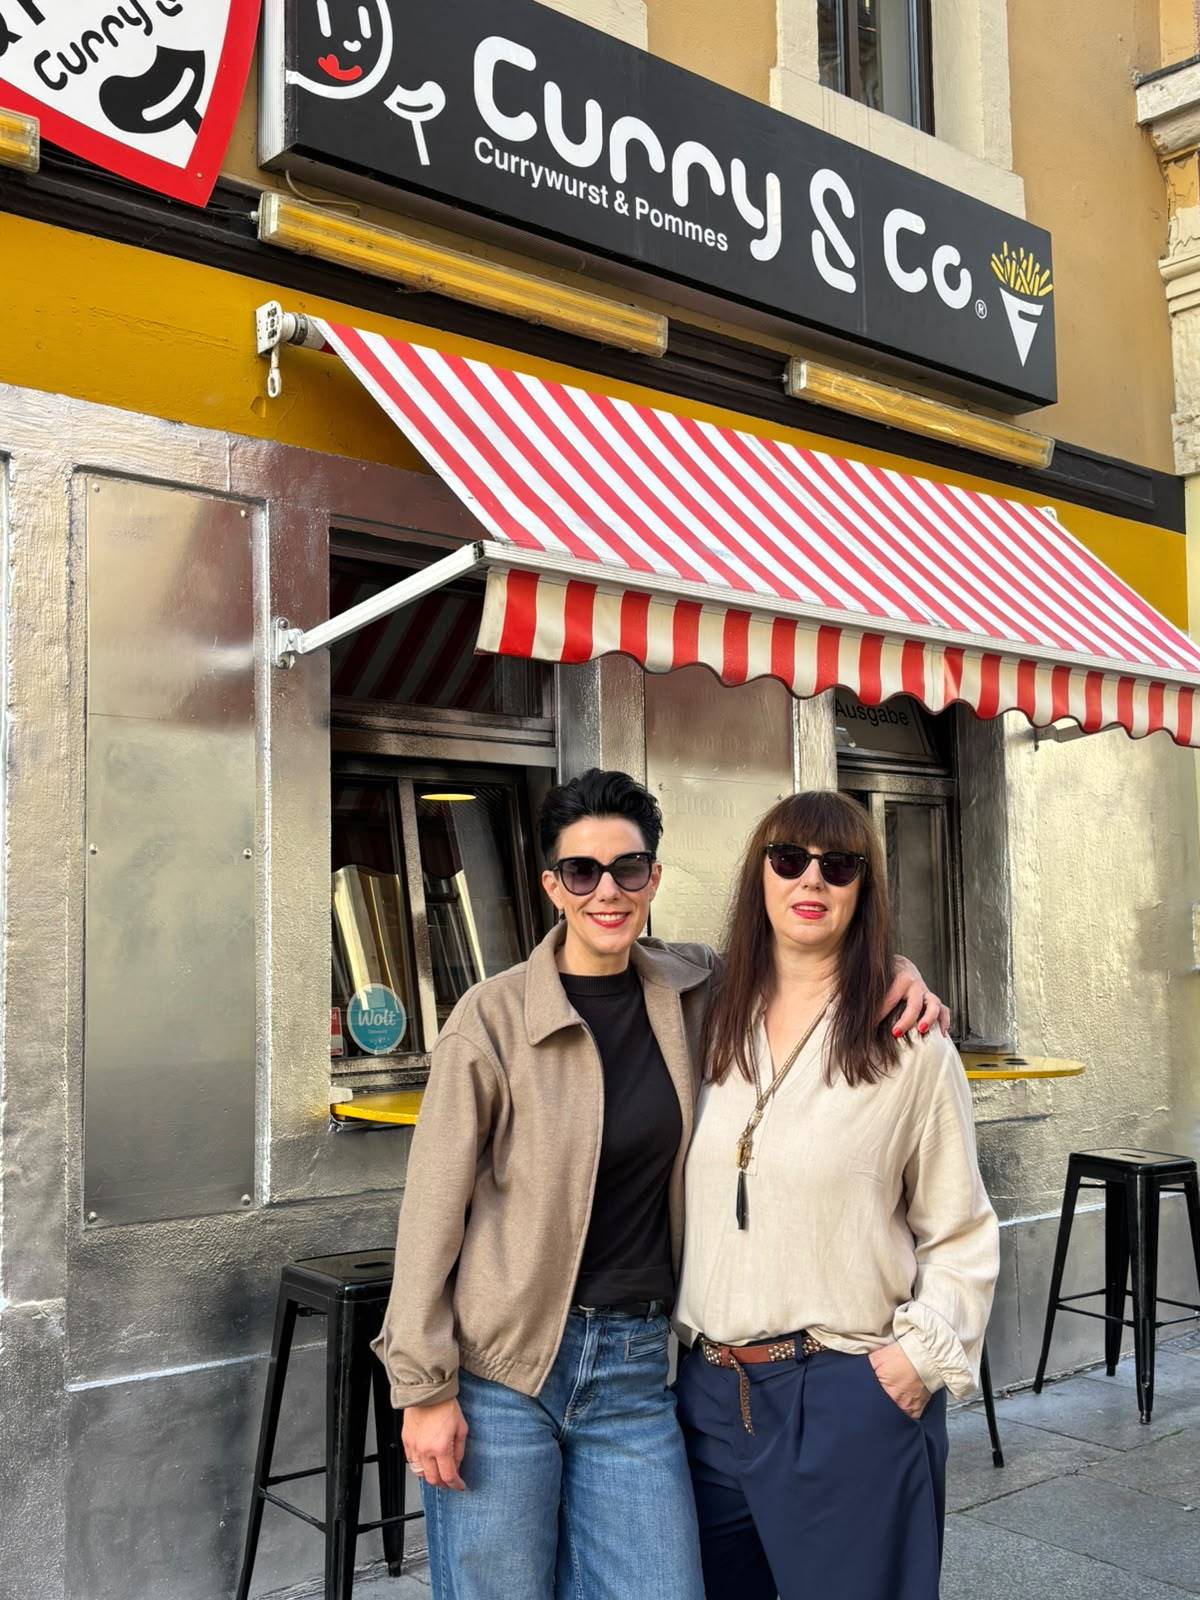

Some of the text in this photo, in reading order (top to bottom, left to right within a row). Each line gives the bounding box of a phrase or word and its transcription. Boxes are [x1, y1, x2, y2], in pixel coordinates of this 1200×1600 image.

[33, 0, 153, 91] Curry
[473, 35, 782, 262] Curry
[809, 168, 857, 294] &
[474, 136, 729, 252] Currywurst & Pommes
[835, 698, 910, 727] Ausgabe
[358, 1009, 397, 1027] Wolt
